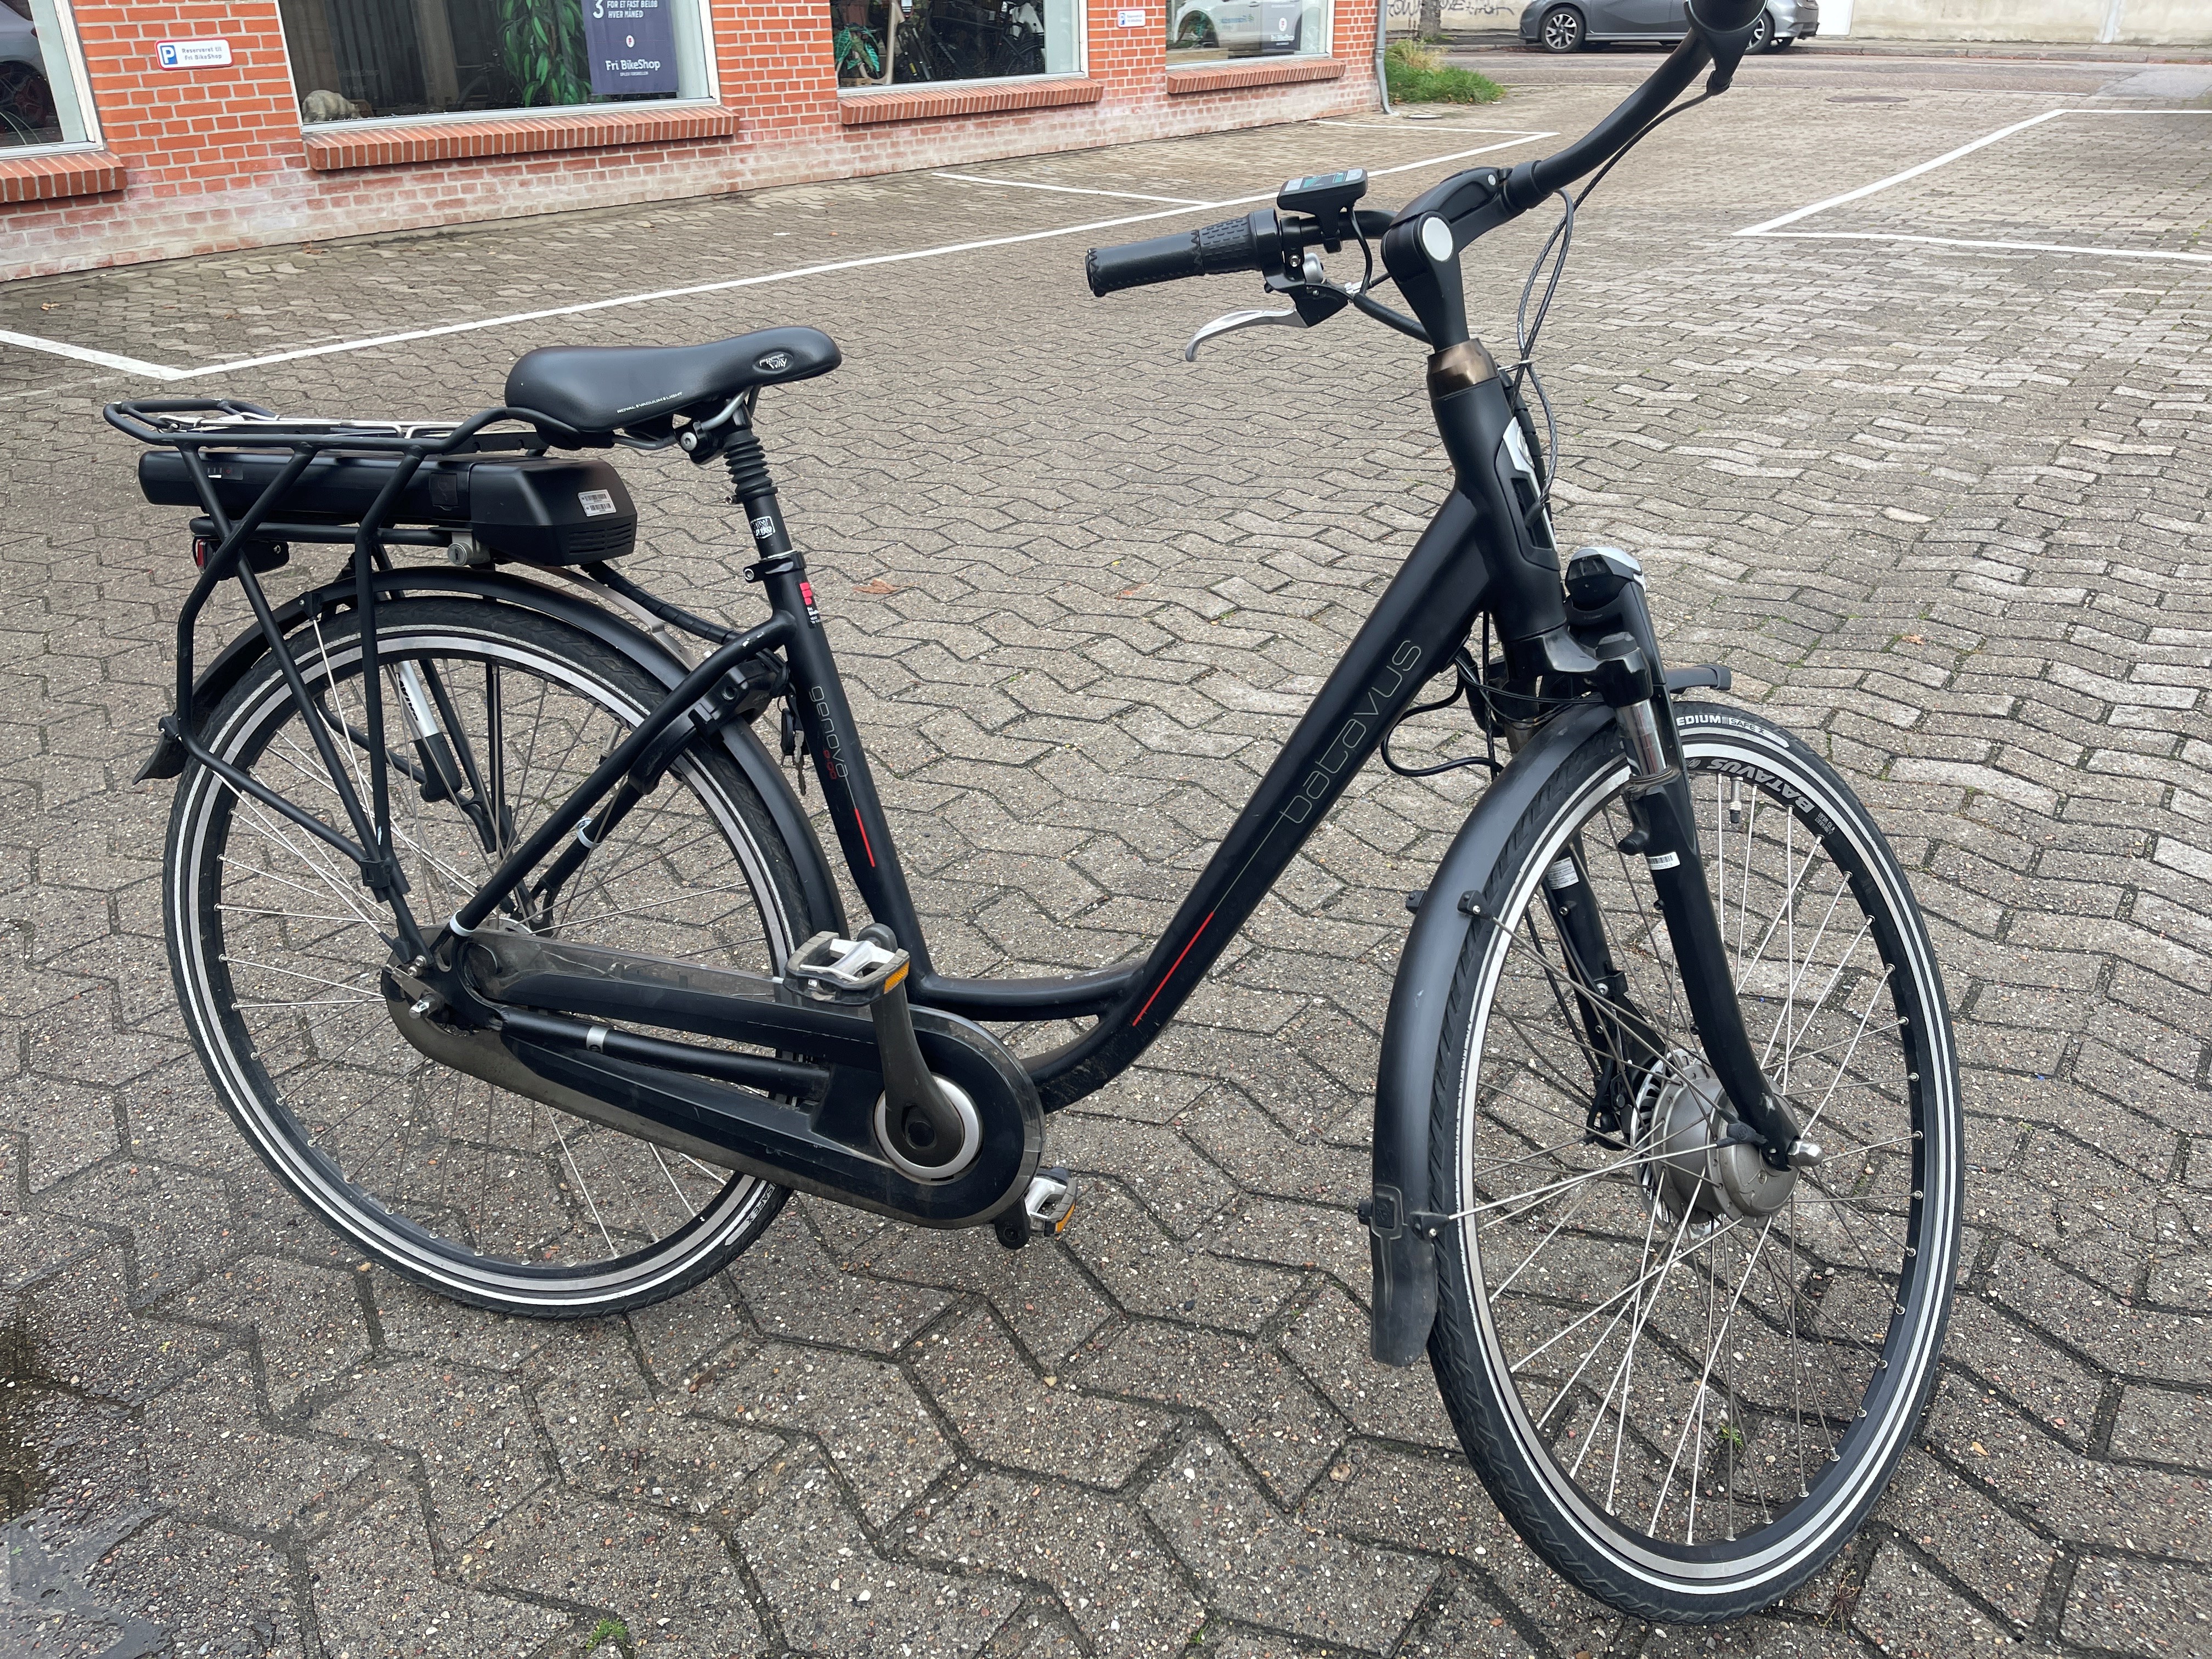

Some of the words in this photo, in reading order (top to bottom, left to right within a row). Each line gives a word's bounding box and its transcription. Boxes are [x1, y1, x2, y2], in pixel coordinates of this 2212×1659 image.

[161, 47, 176, 64] P
[605, 60, 619, 71] Fri
[620, 59, 661, 71] BikeShop
[617, 405, 636, 414] ROYAL
[1676, 714, 1722, 726] EDIUM
[1730, 719, 1756, 731] SAFE
[808, 685, 849, 778] genova
[1706, 758, 1815, 814] BATAVUS
[753, 1186, 773, 1215] SAFE
[746, 1215, 754, 1224] X
